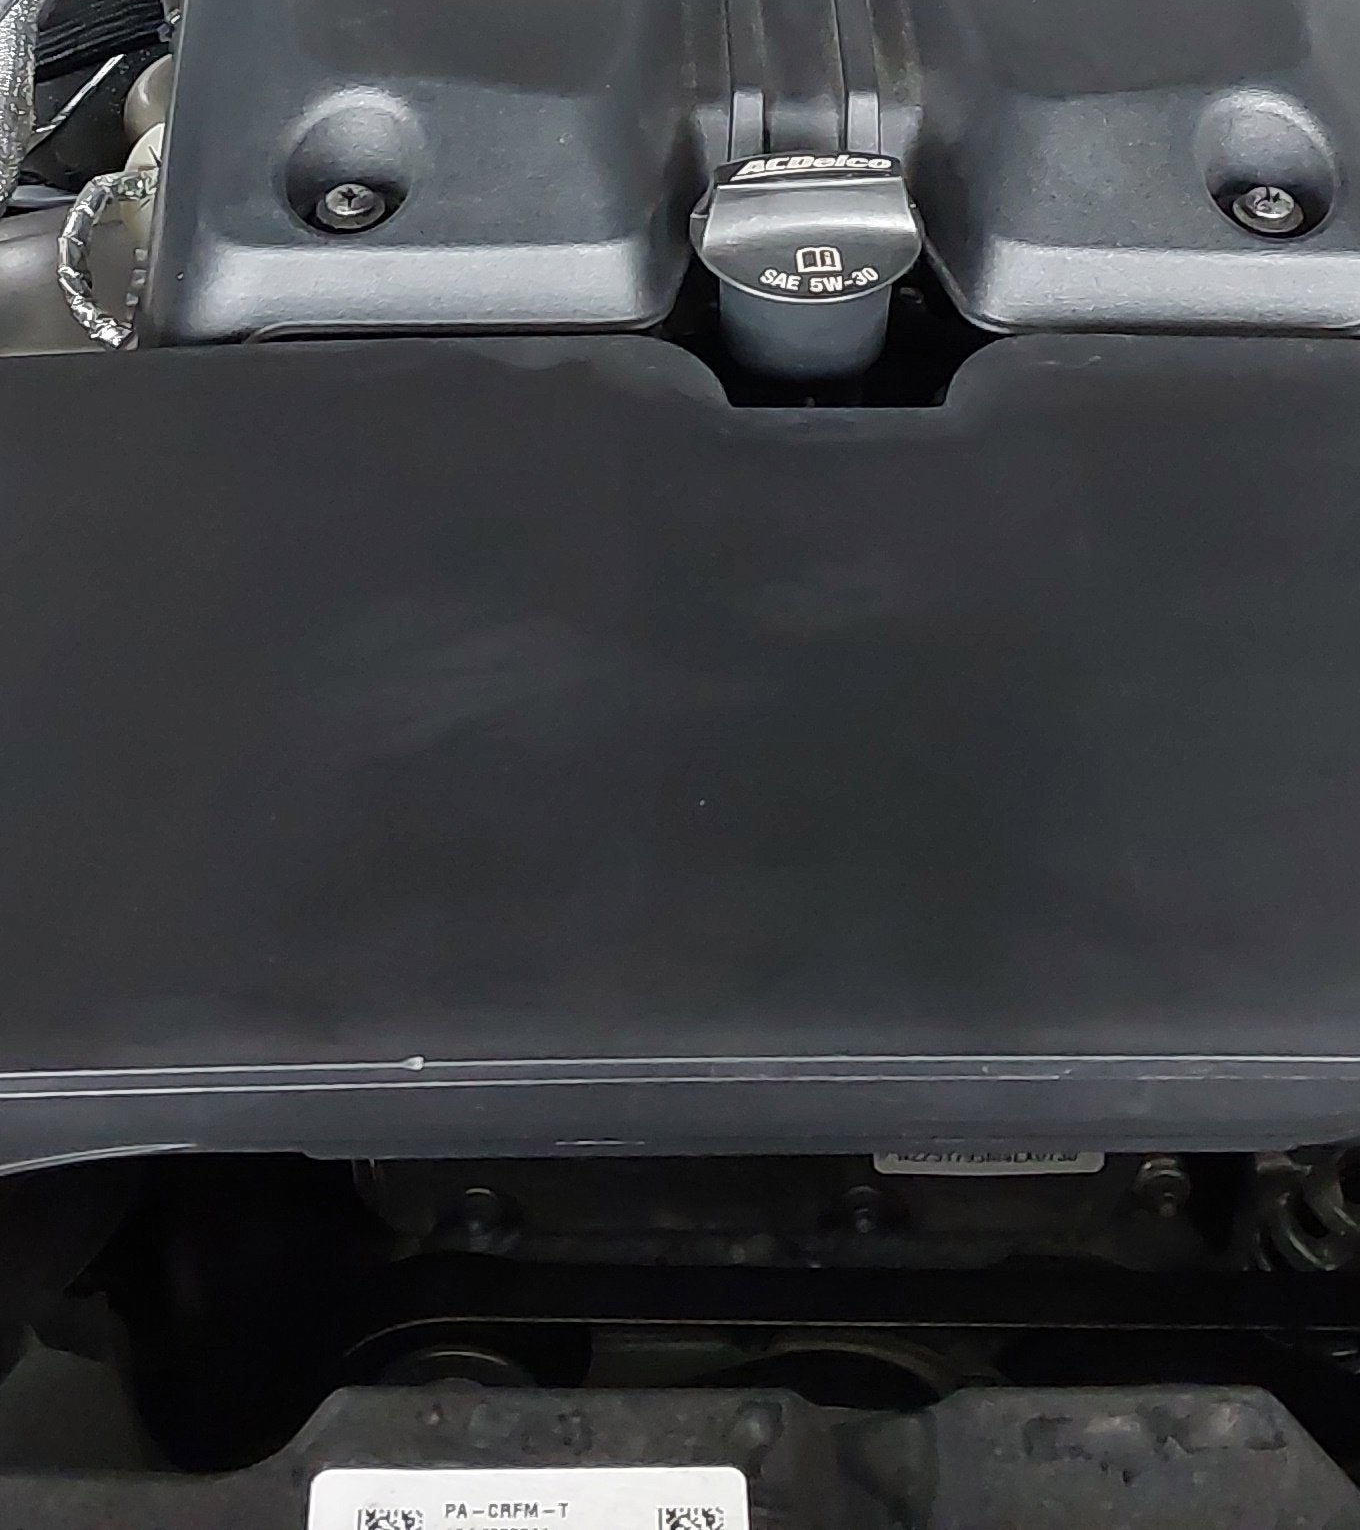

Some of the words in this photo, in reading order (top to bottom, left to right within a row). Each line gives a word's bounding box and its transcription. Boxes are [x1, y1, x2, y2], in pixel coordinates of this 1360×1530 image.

[736, 154, 892, 176] ACDelco
[759, 269, 801, 291] SAE
[809, 267, 879, 293] 5W-30
